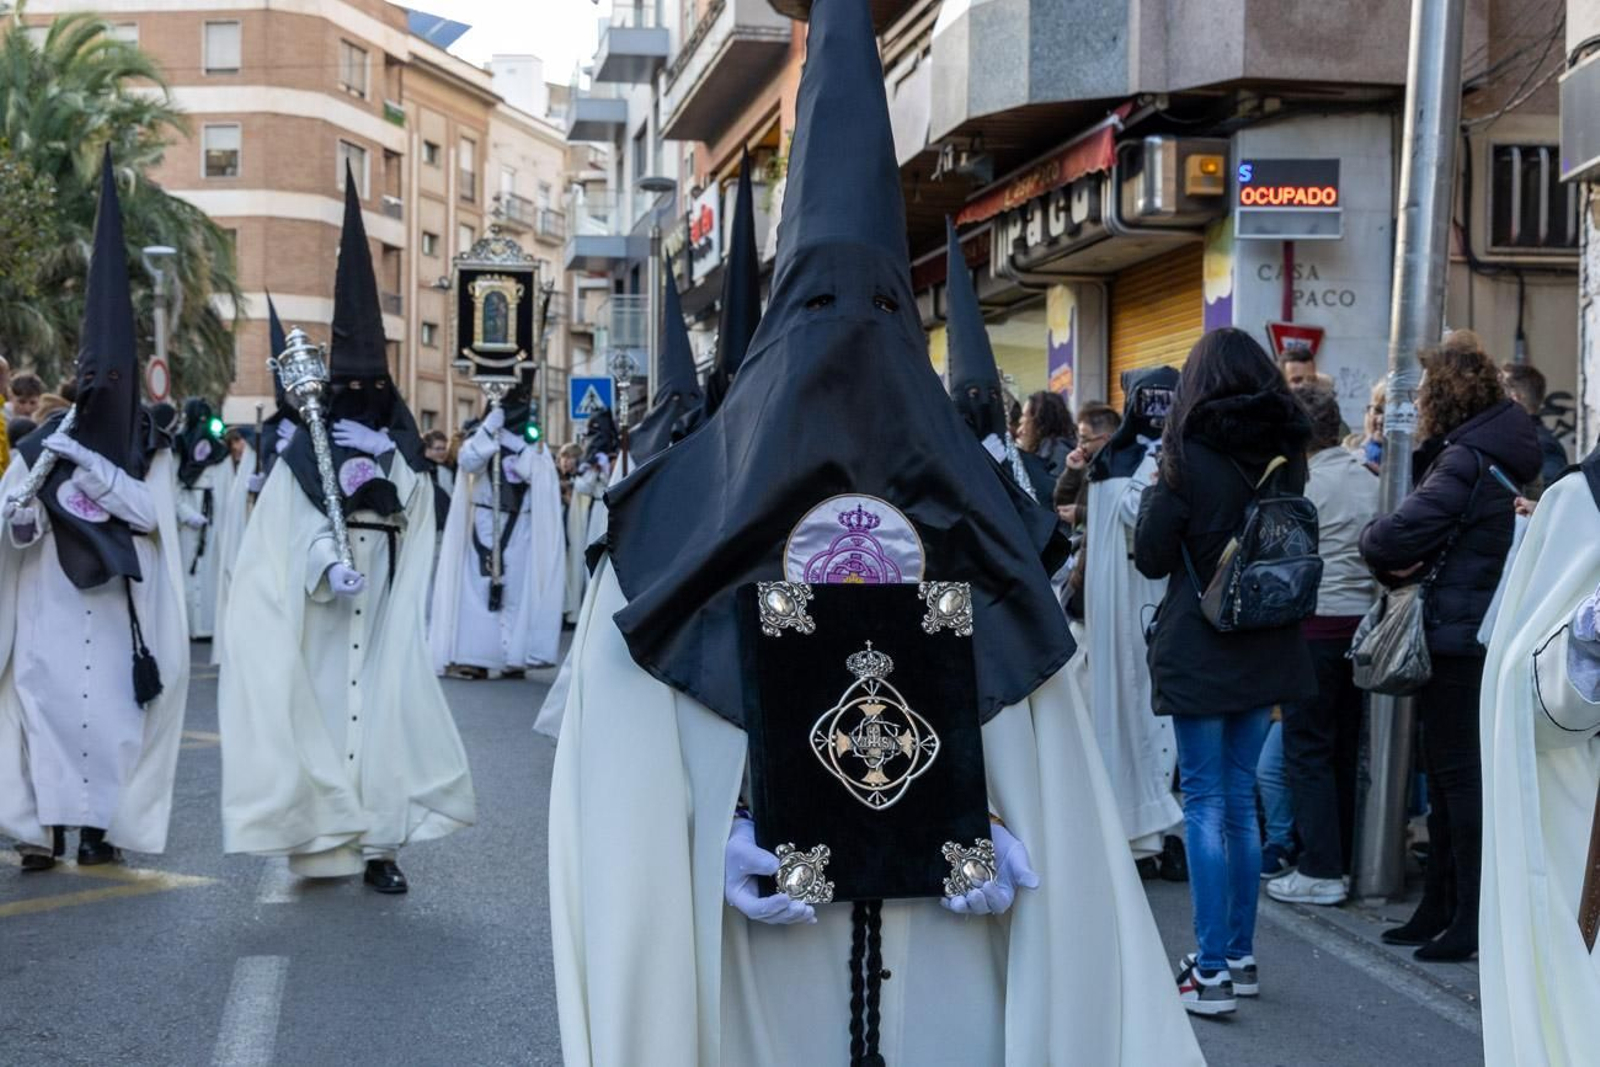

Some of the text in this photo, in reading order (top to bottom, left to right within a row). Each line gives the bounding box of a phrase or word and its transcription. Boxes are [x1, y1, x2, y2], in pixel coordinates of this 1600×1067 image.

[1238, 164, 1253, 182] S
[1240, 187, 1337, 205] OCUPADO
[1292, 289, 1356, 307] PACO
